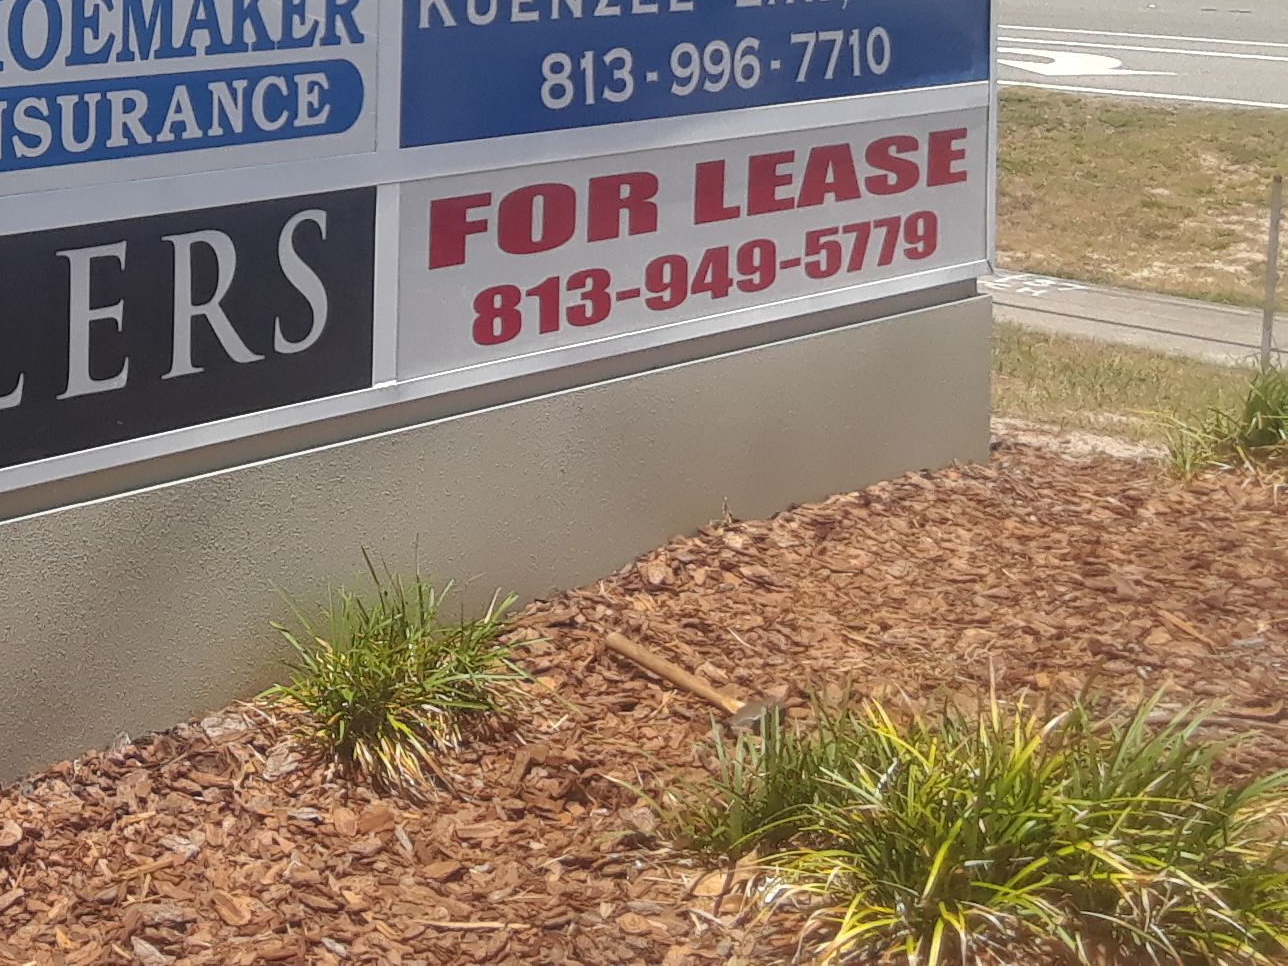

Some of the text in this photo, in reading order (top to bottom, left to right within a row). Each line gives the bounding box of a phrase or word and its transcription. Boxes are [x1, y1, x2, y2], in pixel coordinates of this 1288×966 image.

[539, 26, 892, 109] 813-996-7710
[428, 127, 969, 270] FOR LEASE
[470, 209, 940, 347] 813-949-5779
